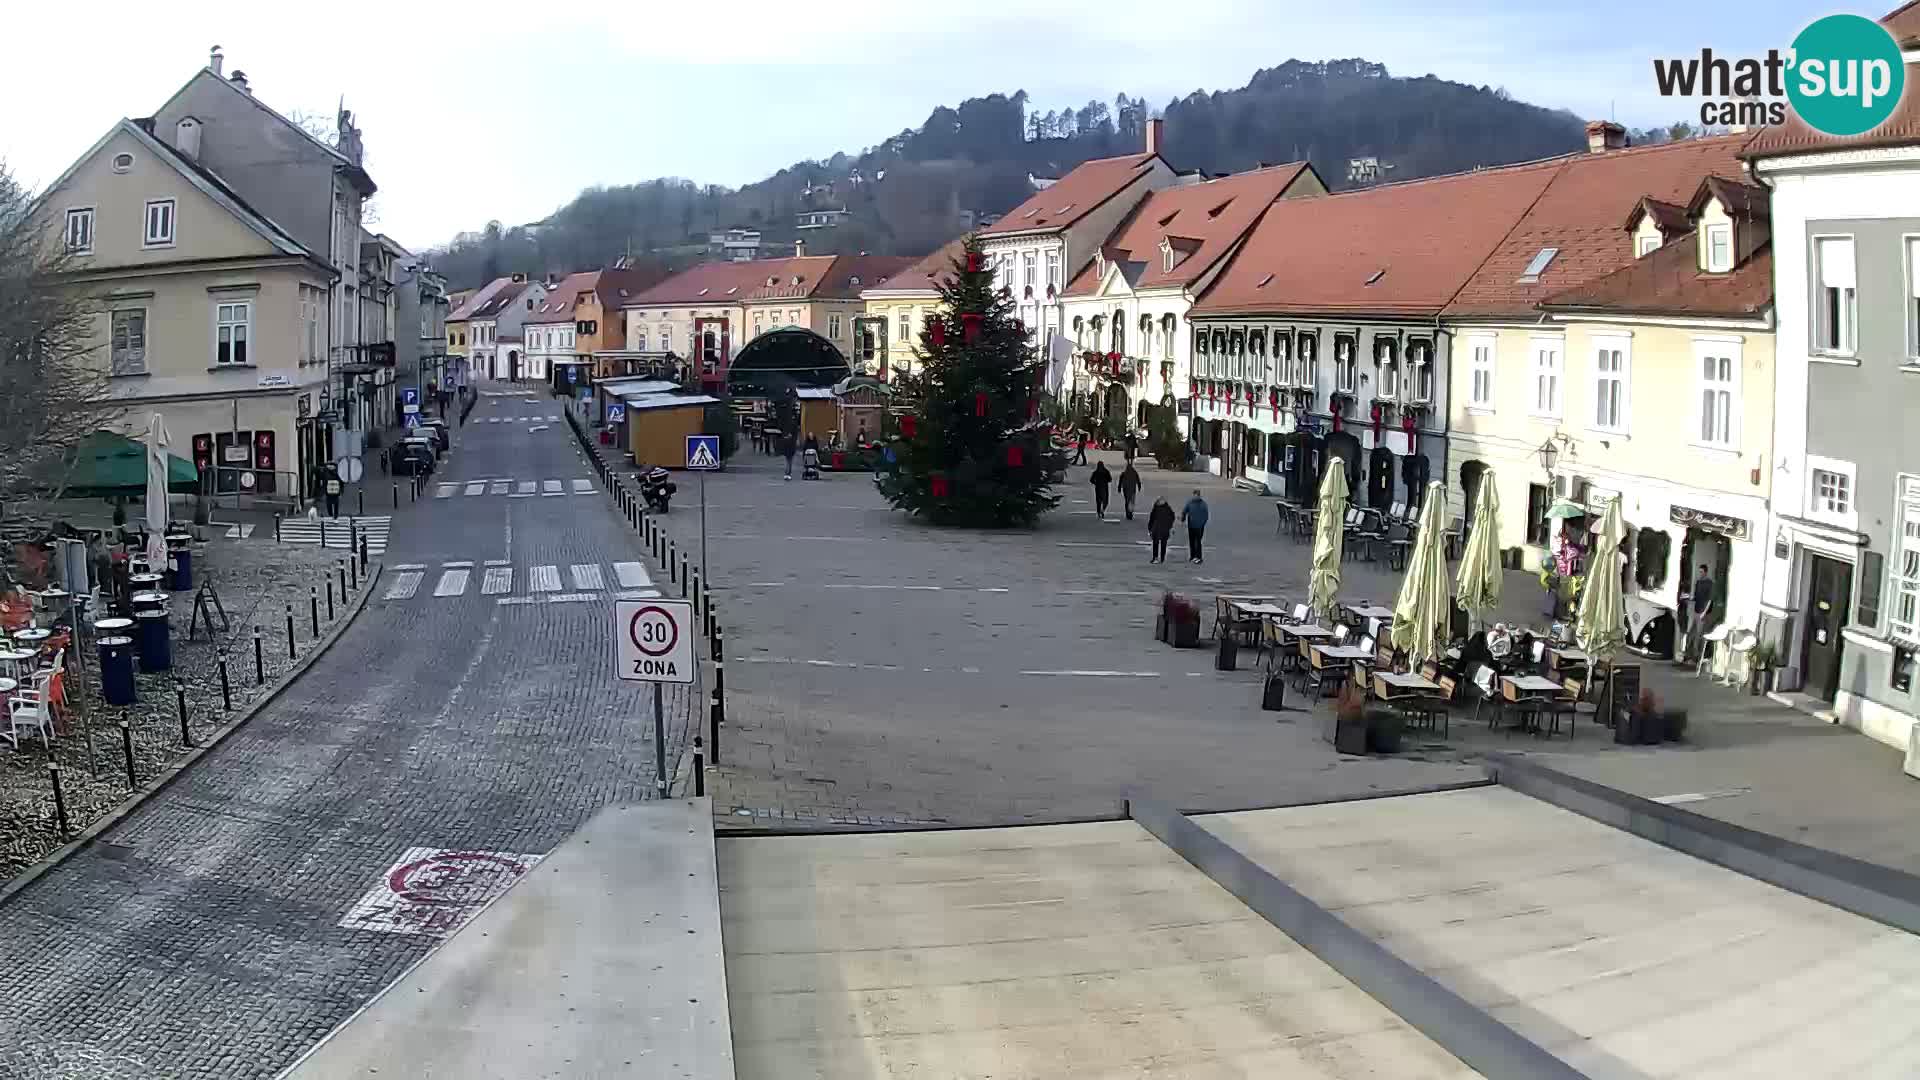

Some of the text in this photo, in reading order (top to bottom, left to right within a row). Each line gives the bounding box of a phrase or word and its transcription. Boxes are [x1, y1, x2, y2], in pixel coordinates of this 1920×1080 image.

[407, 391, 415, 403] P
[642, 622, 667, 642] 30
[633, 659, 677, 676] ZONA
